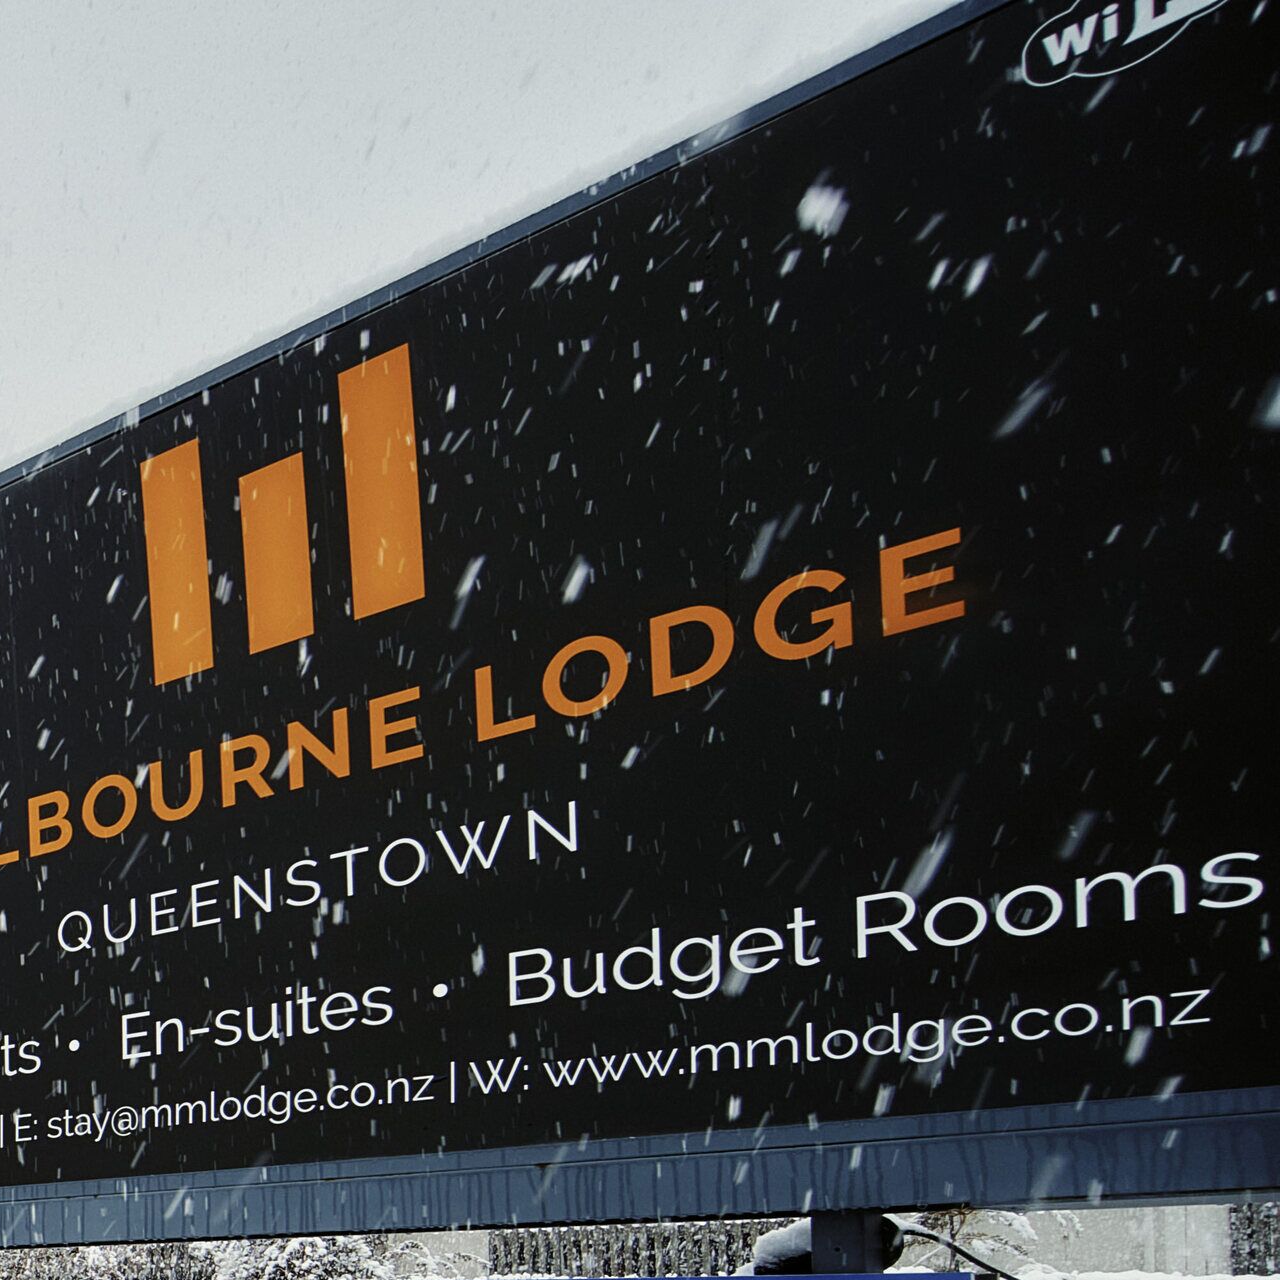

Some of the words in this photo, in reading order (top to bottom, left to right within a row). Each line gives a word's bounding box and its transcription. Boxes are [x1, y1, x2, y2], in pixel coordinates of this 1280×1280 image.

[474, 526, 966, 741] LODGE
[56, 800, 579, 953] QUEENSTOWN
[121, 983, 394, 1060] En-suites
[508, 906, 820, 1007] Budget
[856, 852, 1264, 958] Rooms
[15, 1112, 40, 1142] E:
[46, 1072, 435, 1143] stay@mmlodge.co.nz
[469, 1055, 531, 1094] W:
[543, 988, 1211, 1088] www.mmlodge.co.nz
